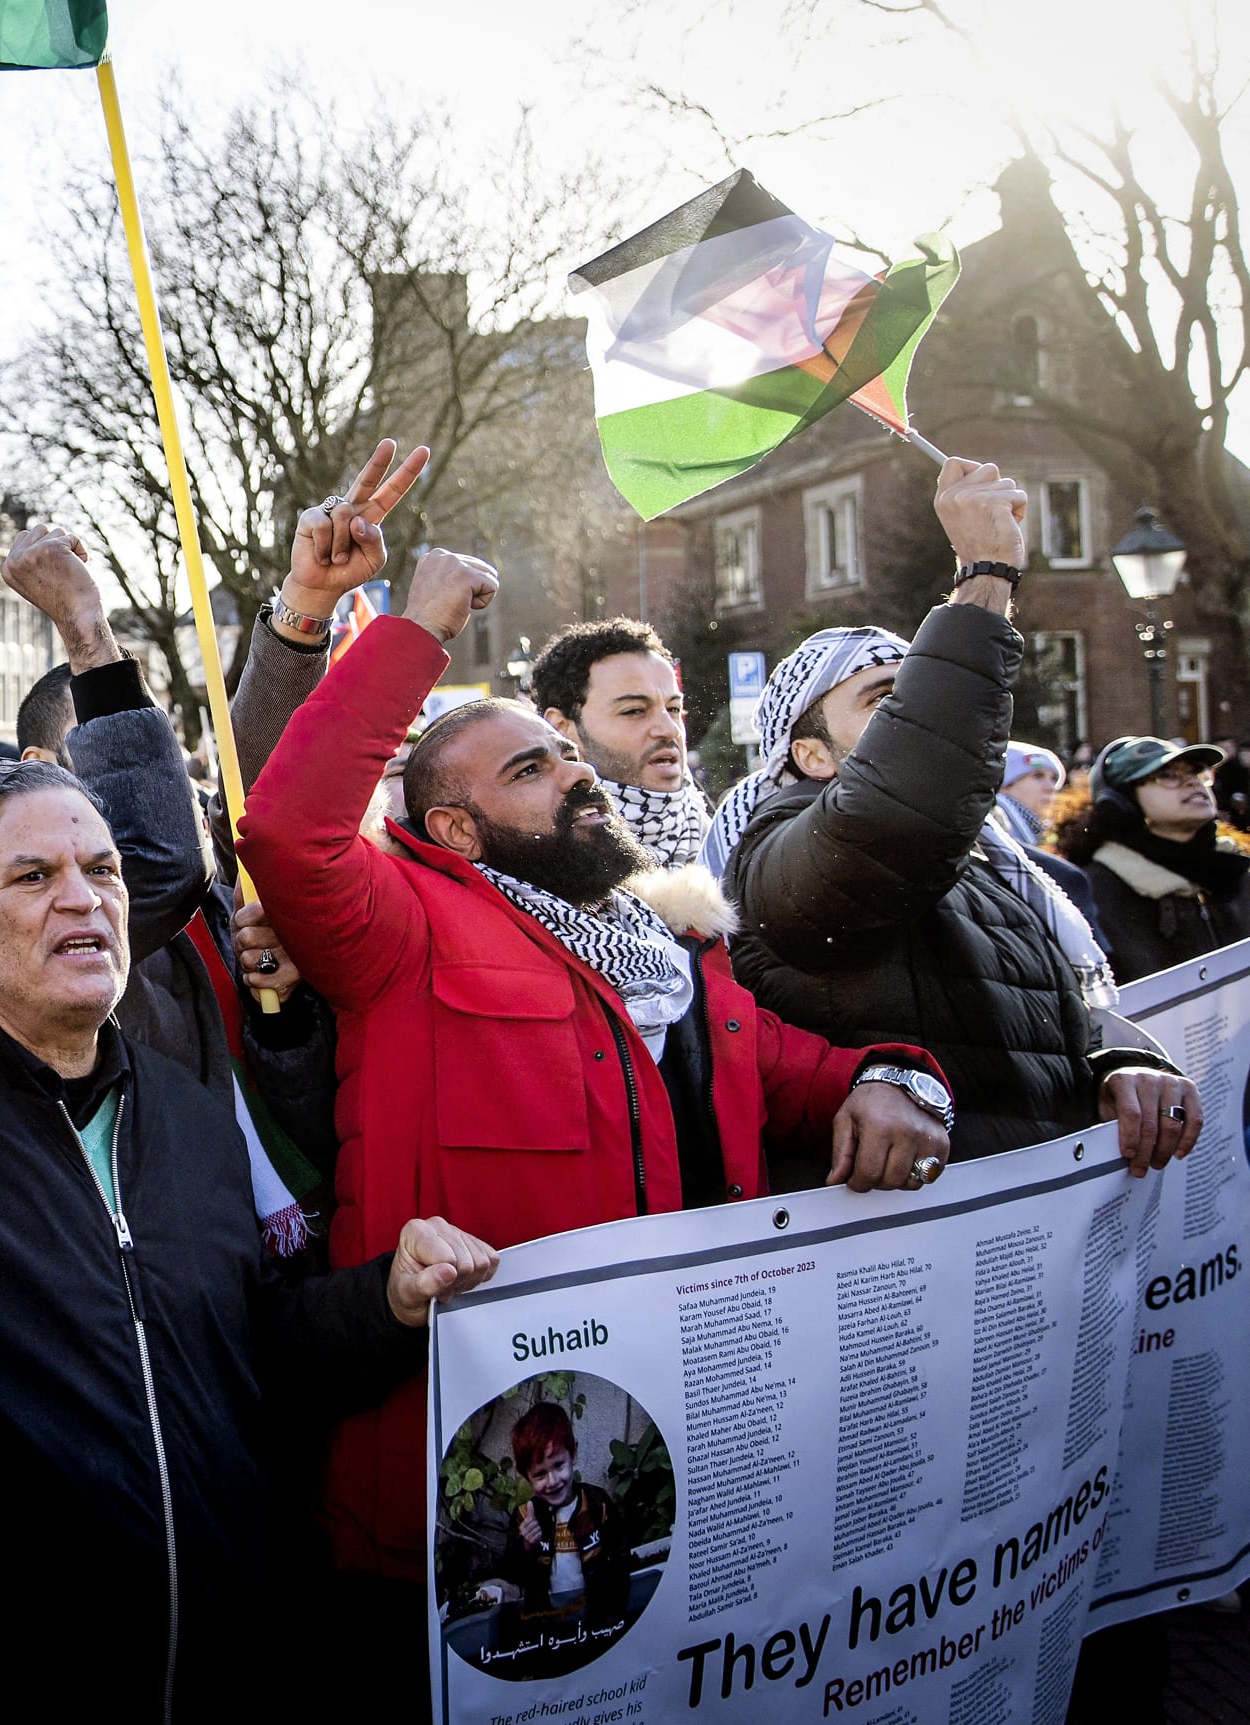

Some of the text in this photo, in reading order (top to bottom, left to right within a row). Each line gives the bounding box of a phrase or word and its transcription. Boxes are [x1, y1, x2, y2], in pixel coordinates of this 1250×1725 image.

[737, 656, 756, 680] P
[676, 1262, 816, 1295] Victims since 7th of October 2023
[1145, 1244, 1242, 1310] eams.
[679, 1303, 698, 1312] Safaa
[699, 1294, 739, 1307] Muhammad
[768, 1286, 776, 1294] 19
[680, 1314, 702, 1322] Karam
[703, 1307, 726, 1318] Yousef
[727, 1305, 740, 1313] Abu
[680, 1324, 703, 1333] Marah
[704, 1315, 744, 1328] Muhammad
[744, 1311, 762, 1320] Saad,
[512, 1318, 609, 1361] Suhaib
[681, 1337, 696, 1345] Saja
[697, 1327, 736, 1341] Muhammad
[738, 1325, 751, 1333] Abu
[752, 1321, 773, 1329] Nema,
[682, 1344, 702, 1355] Malak
[704, 1336, 743, 1350] Muhammad
[744, 1334, 757, 1342] Abu
[782, 1326, 789, 1334] 16
[1134, 1328, 1175, 1354] ine
[683, 1354, 718, 1366] Moatasem
[719, 1350, 736, 1358] Rami
[683, 1370, 696, 1378] Aya
[697, 1359, 737, 1374] Mohammed
[765, 1351, 773, 1359] 15
[684, 1378, 704, 1388] Razan
[706, 1369, 744, 1383] Mohammed
[745, 1364, 762, 1374] Saad,
[685, 1389, 701, 1399] Basil
[702, 1386, 720, 1395] Thaer
[685, 1400, 710, 1410] Sundos
[711, 1389, 749, 1403] Muhammad
[751, 1386, 763, 1394] Abu
[686, 1411, 700, 1421] Bilal
[702, 1402, 741, 1416] Muhammad
[687, 1421, 712, 1431] Mumen
[713, 1415, 739, 1425] Hussam
[687, 1431, 709, 1442] Khaled
[711, 1427, 732, 1436] Maher
[733, 1423, 746, 1431] Abu
[770, 1414, 777, 1422] 12
[687, 1443, 706, 1453] Farah
[707, 1433, 746, 1448] Muhammad
[687, 1453, 710, 1464] Ghazal
[711, 1448, 734, 1458] Hassan
[735, 1444, 749, 1452] Abu
[772, 1434, 779, 1442] 12
[687, 1465, 709, 1475] Sultan
[709, 1460, 729, 1469] Thaer
[688, 1475, 712, 1485] Hassan
[713, 1463, 751, 1478] Muhammad
[717, 1472, 754, 1488] Muhammad
[755, 1463, 791, 1477] Al-Mahlawi,
[677, 1614, 831, 1709] They
[848, 1558, 977, 1650] have
[992, 1465, 1110, 1588] names.
[591, 1619, 625, 1639] صهيب
[823, 1625, 985, 1718] Remember
[991, 1599, 1024, 1641] the
[1030, 1540, 1089, 1611] victims
[515, 1695, 584, 1724] red-haired
[586, 1683, 627, 1707] school
[629, 1675, 647, 1694] kid
[593, 1708, 623, 1725] gives
[627, 1700, 642, 1717] his
